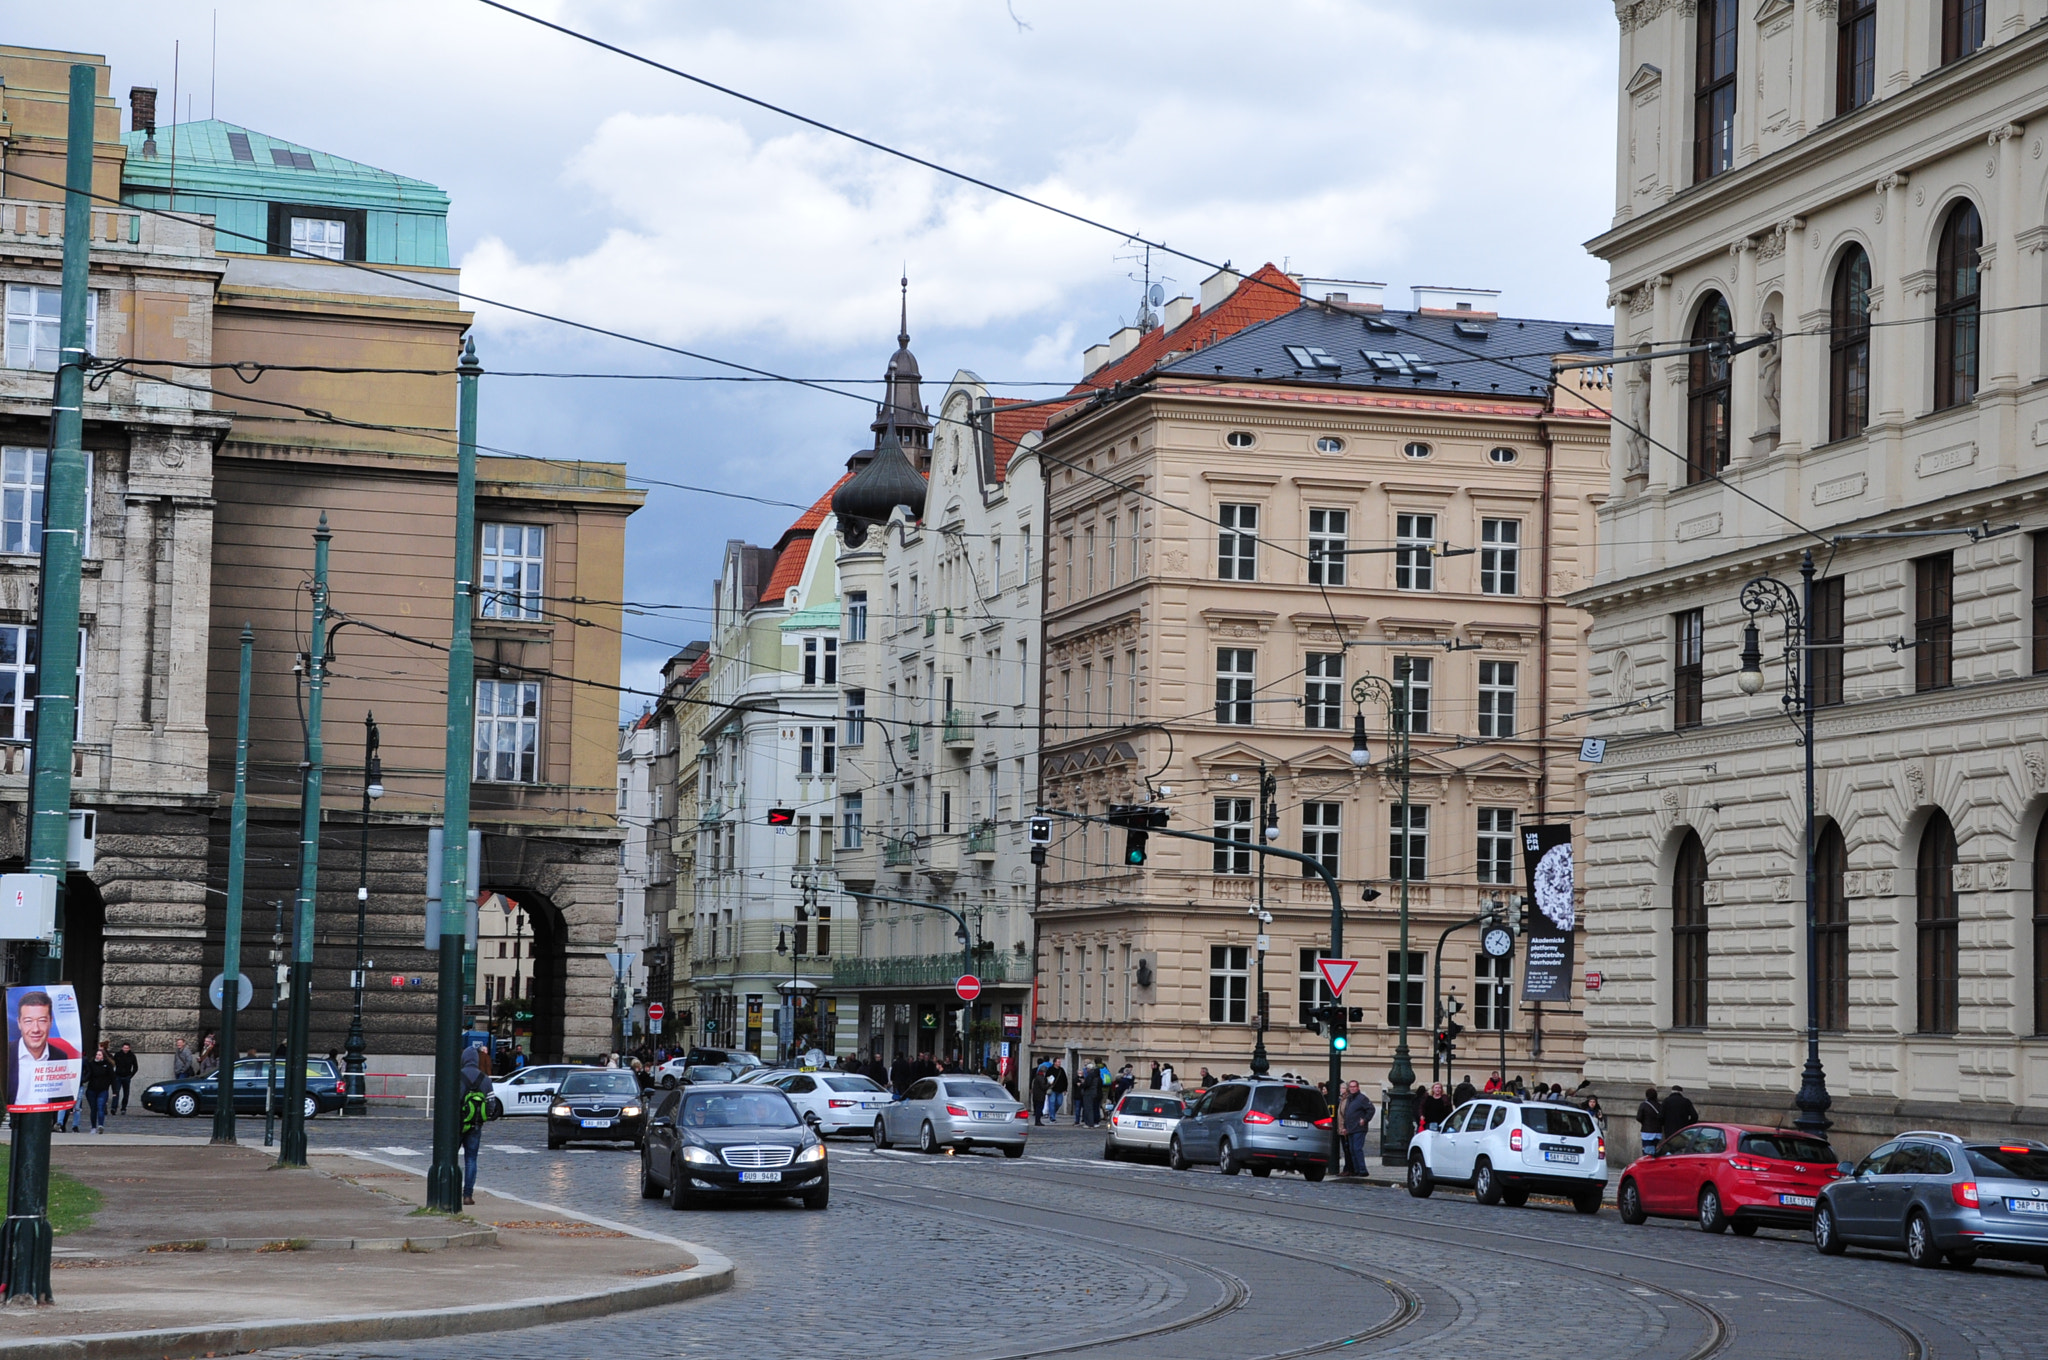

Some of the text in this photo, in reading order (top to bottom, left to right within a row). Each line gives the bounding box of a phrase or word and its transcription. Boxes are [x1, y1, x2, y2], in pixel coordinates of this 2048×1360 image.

[45, 1065, 67, 1073] ISLÁMU
[744, 1172, 778, 1180] 6U9 9482
[2016, 1200, 2031, 1210] 3AP
